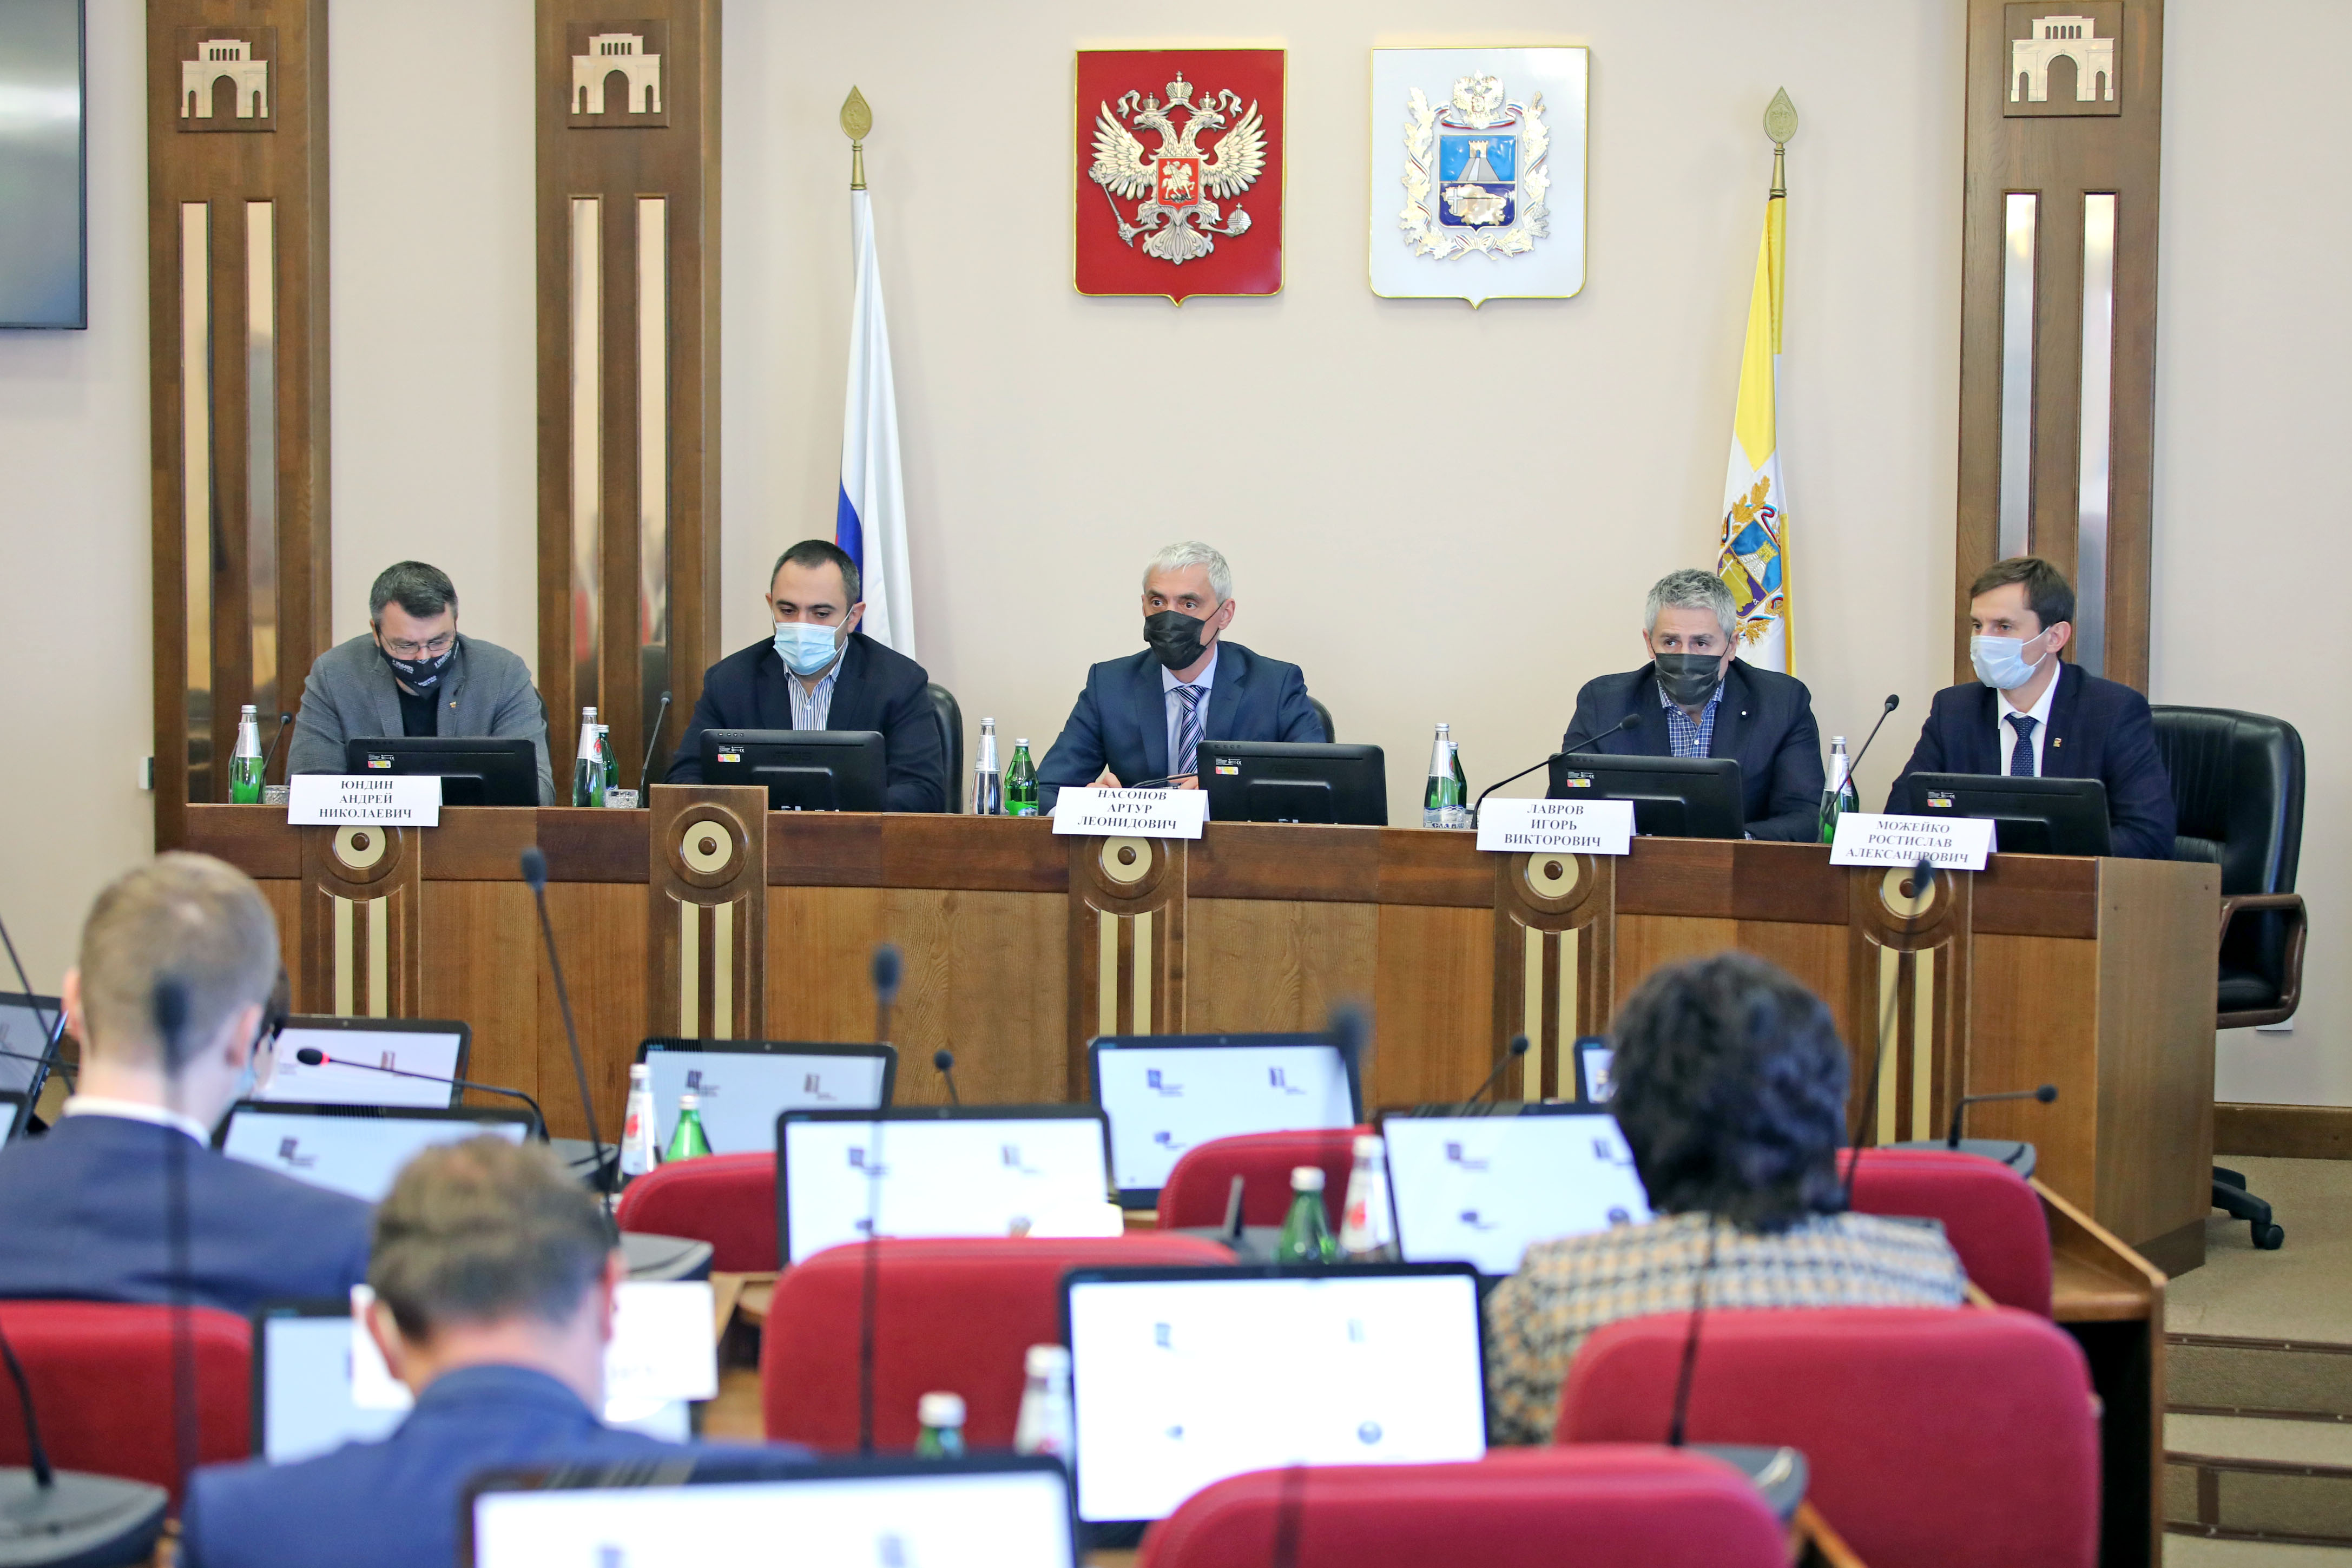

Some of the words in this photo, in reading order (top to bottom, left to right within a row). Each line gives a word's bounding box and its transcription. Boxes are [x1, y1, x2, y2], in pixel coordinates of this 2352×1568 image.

[341, 781, 393, 790] ЮНДИН
[339, 793, 393, 805] АНДРЕЙ
[1098, 790, 1167, 800] НАСОНОВ
[319, 808, 412, 818] НИКОЛАЕВИЧ
[1107, 803, 1152, 814] АРТУР
[1527, 804, 1584, 815] ЛАВРОВ
[1077, 816, 1177, 829] ЛЕОНИДОВИЧ
[1531, 819, 1577, 830] ИГОРЬ
[1875, 821, 1950, 833] МОЖЕЙКО
[1504, 834, 1601, 847] ВИКТОРОВИЧ
[1868, 834, 1952, 847] РОСТИСЛАВ
[1845, 848, 1969, 863] АЛЕКСАНДРОВИЧ
